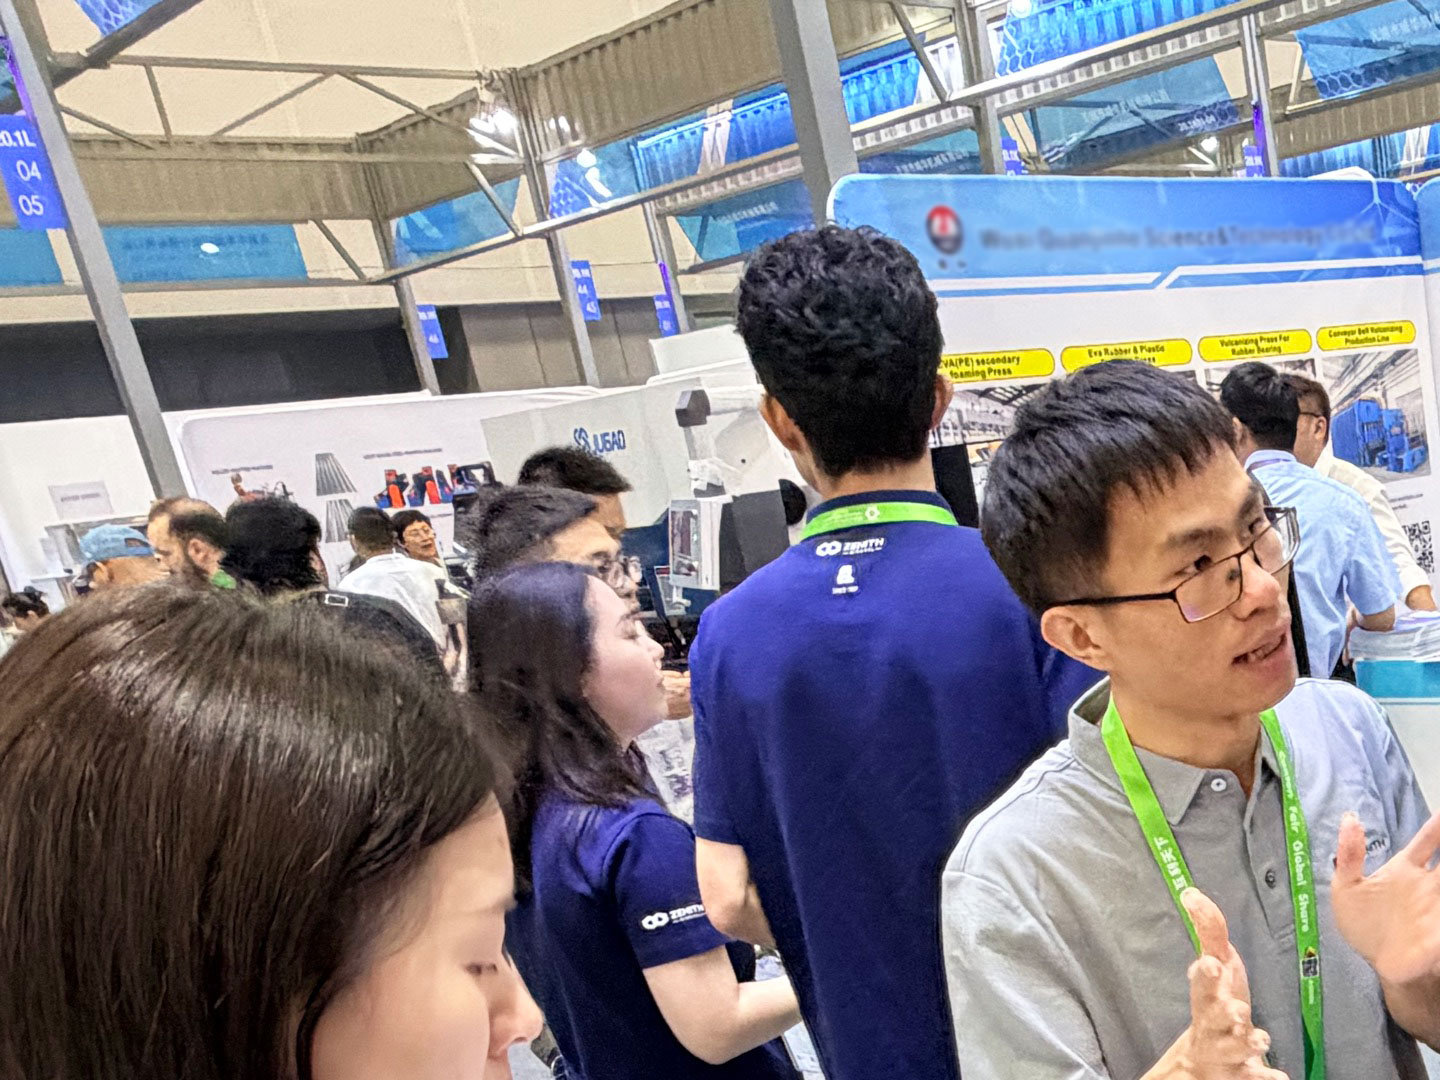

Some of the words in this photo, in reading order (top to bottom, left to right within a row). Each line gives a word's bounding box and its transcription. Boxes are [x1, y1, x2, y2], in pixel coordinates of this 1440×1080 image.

[0, 130, 36, 147] 0.1L
[16, 160, 42, 181] 04
[18, 194, 44, 216] 05
[976, 354, 1021, 367] secondary
[949, 366, 987, 379] foaming
[987, 365, 1012, 377] Press
[1292, 840, 1307, 887] Global
[1298, 893, 1310, 933] Share
